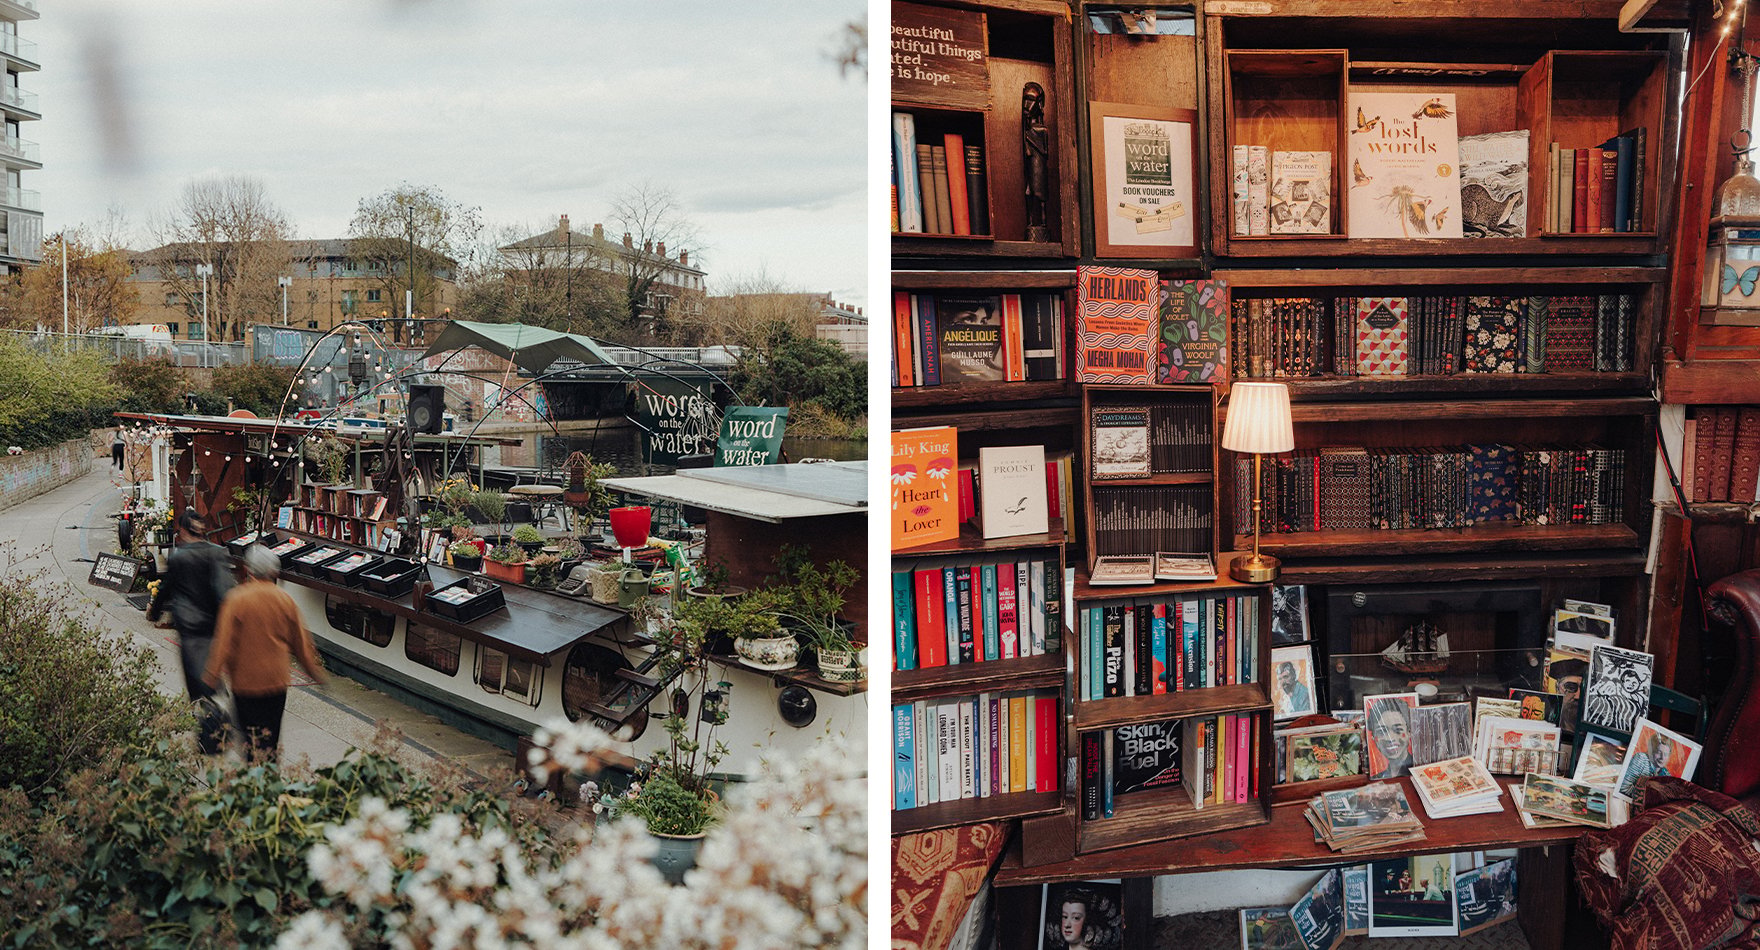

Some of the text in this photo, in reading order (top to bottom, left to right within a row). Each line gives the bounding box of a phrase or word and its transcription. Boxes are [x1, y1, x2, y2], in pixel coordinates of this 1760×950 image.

[938, 43, 981, 61] things
[898, 66, 956, 86] is hope.
[1381, 121, 1417, 138] lost
[1127, 141, 1168, 156] word
[1368, 136, 1436, 153] words
[1130, 161, 1168, 172] water
[1123, 187, 1175, 196] BOOK VOUCHERS
[1090, 277, 1146, 301] HERLANDS
[944, 328, 998, 341] ANGÉLIQUE
[925, 319, 934, 373] AMERICANAH
[1087, 350, 1144, 369] MEGHA MOHAN
[645, 385, 702, 417] word
[659, 418, 682, 428] on the
[729, 414, 777, 439] word
[650, 432, 700, 454] water
[891, 442, 949, 458] Lily King
[723, 448, 770, 466] water
[994, 465, 1035, 473] PROUST
[903, 489, 940, 503] Heart
[915, 506, 929, 514] the
[904, 519, 941, 532] Lover
[946, 571, 954, 603] ORANGE
[960, 591, 970, 631] HIGH VAULTAGE
[1188, 630, 1194, 638] In
[1106, 646, 1121, 684] Puzo
[939, 714, 948, 755] LEONARD COHEN
[1118, 723, 1165, 741] Skin,
[1125, 734, 1178, 754] Black
[1119, 752, 1159, 771] Fuel
